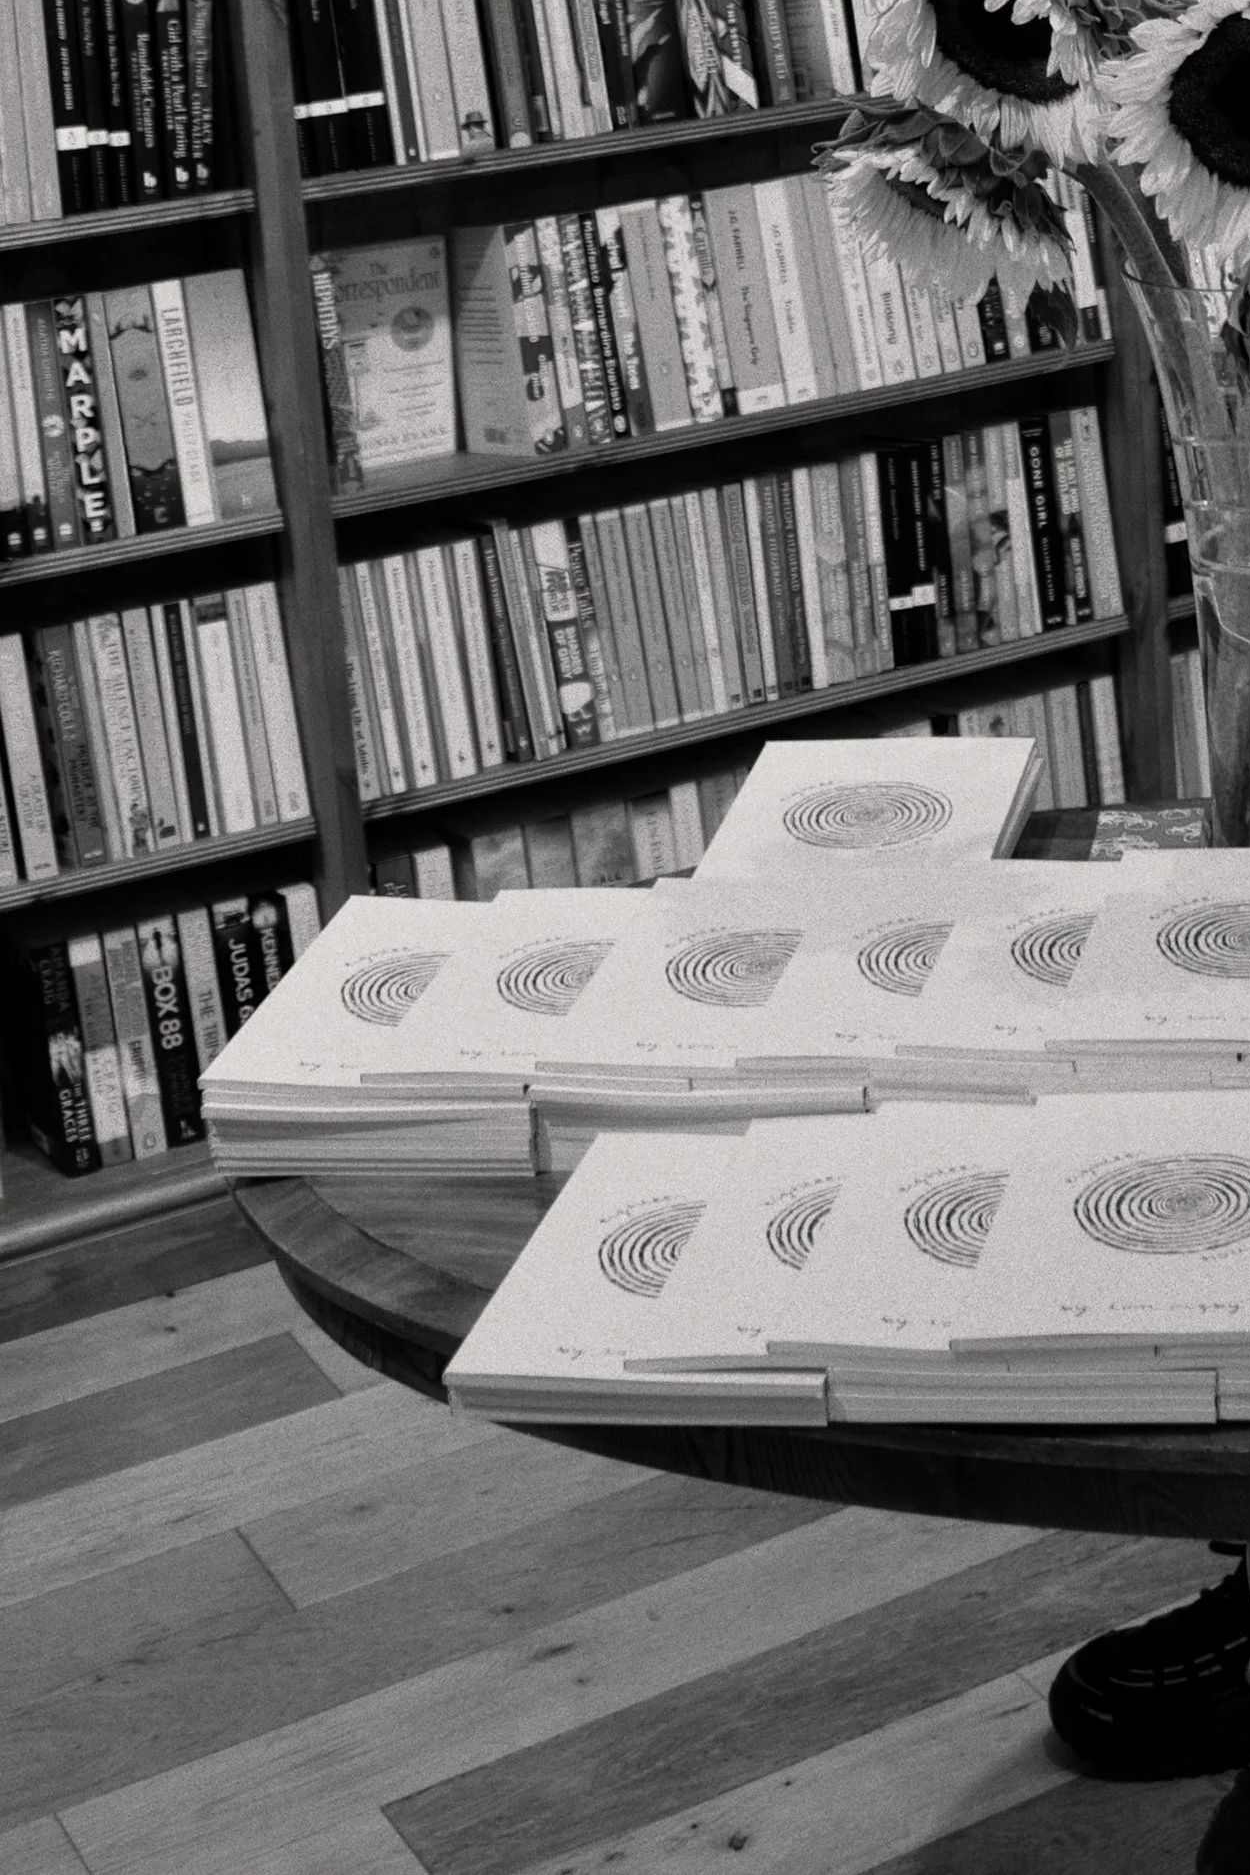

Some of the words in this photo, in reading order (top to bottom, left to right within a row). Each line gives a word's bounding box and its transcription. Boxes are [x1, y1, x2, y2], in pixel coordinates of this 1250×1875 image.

[167, 18, 181, 45] Girl
[726, 3, 737, 25] THE
[135, 32, 153, 96] Remarkable
[169, 46, 183, 73] with
[195, 50, 207, 89] Thread
[774, 52, 787, 81] RED
[132, 82, 143, 132] CHEVALIER
[163, 80, 174, 131] CHEVALIER
[170, 84, 184, 114] Pearl
[141, 97, 155, 149] Creatures
[174, 115, 189, 160] Earring
[190, 91, 203, 160] CHEVALIER
[201, 106, 212, 146] TRACY
[515, 234, 531, 296] Bernardine
[730, 227, 745, 272] FARRELL
[772, 242, 788, 285] FARRELL
[311, 271, 340, 350] NEPHTHYS
[582, 220, 600, 284] Manifesto
[593, 288, 613, 358] Bernardine
[604, 359, 621, 411] Evaristo
[742, 304, 757, 346] Singapore
[880, 291, 898, 345] Birdsong
[36, 318, 52, 358] AGATHA
[160, 307, 195, 408] LARCHFIELD
[622, 331, 634, 356] The
[749, 347, 760, 366] Grip
[626, 357, 639, 391] Trees
[57, 328, 108, 518] MARPLE
[1029, 445, 1044, 490] GONE
[1056, 462, 1070, 515] SCOTLAND
[1066, 460, 1077, 486] LAST
[764, 485, 776, 535] PENELOPE
[781, 481, 794, 531] PENELOPE
[1034, 494, 1047, 530] GIRL
[568, 542, 587, 588] Peace
[785, 534, 800, 593] FITZGERALD
[577, 591, 595, 629] Talks
[554, 629, 567, 647] OF
[565, 626, 583, 676] SHADES
[46, 649, 70, 702] RICHARD
[557, 648, 573, 679] GREY
[114, 673, 131, 734] SILENCE
[123, 737, 142, 803] FACTORY
[351, 710, 364, 729] Life
[78, 744, 91, 789] MURDER
[69, 759, 84, 823] MONASTERY
[38, 958, 54, 1005] CRAIG
[48, 947, 69, 1013] AMANDA
[151, 965, 176, 1016] BOX
[227, 938, 252, 1002] JUDAS
[199, 989, 217, 1018] THE
[161, 1018, 183, 1051] 88
[58, 1088, 75, 1144] GRACES
[74, 1099, 91, 1144] THREE
